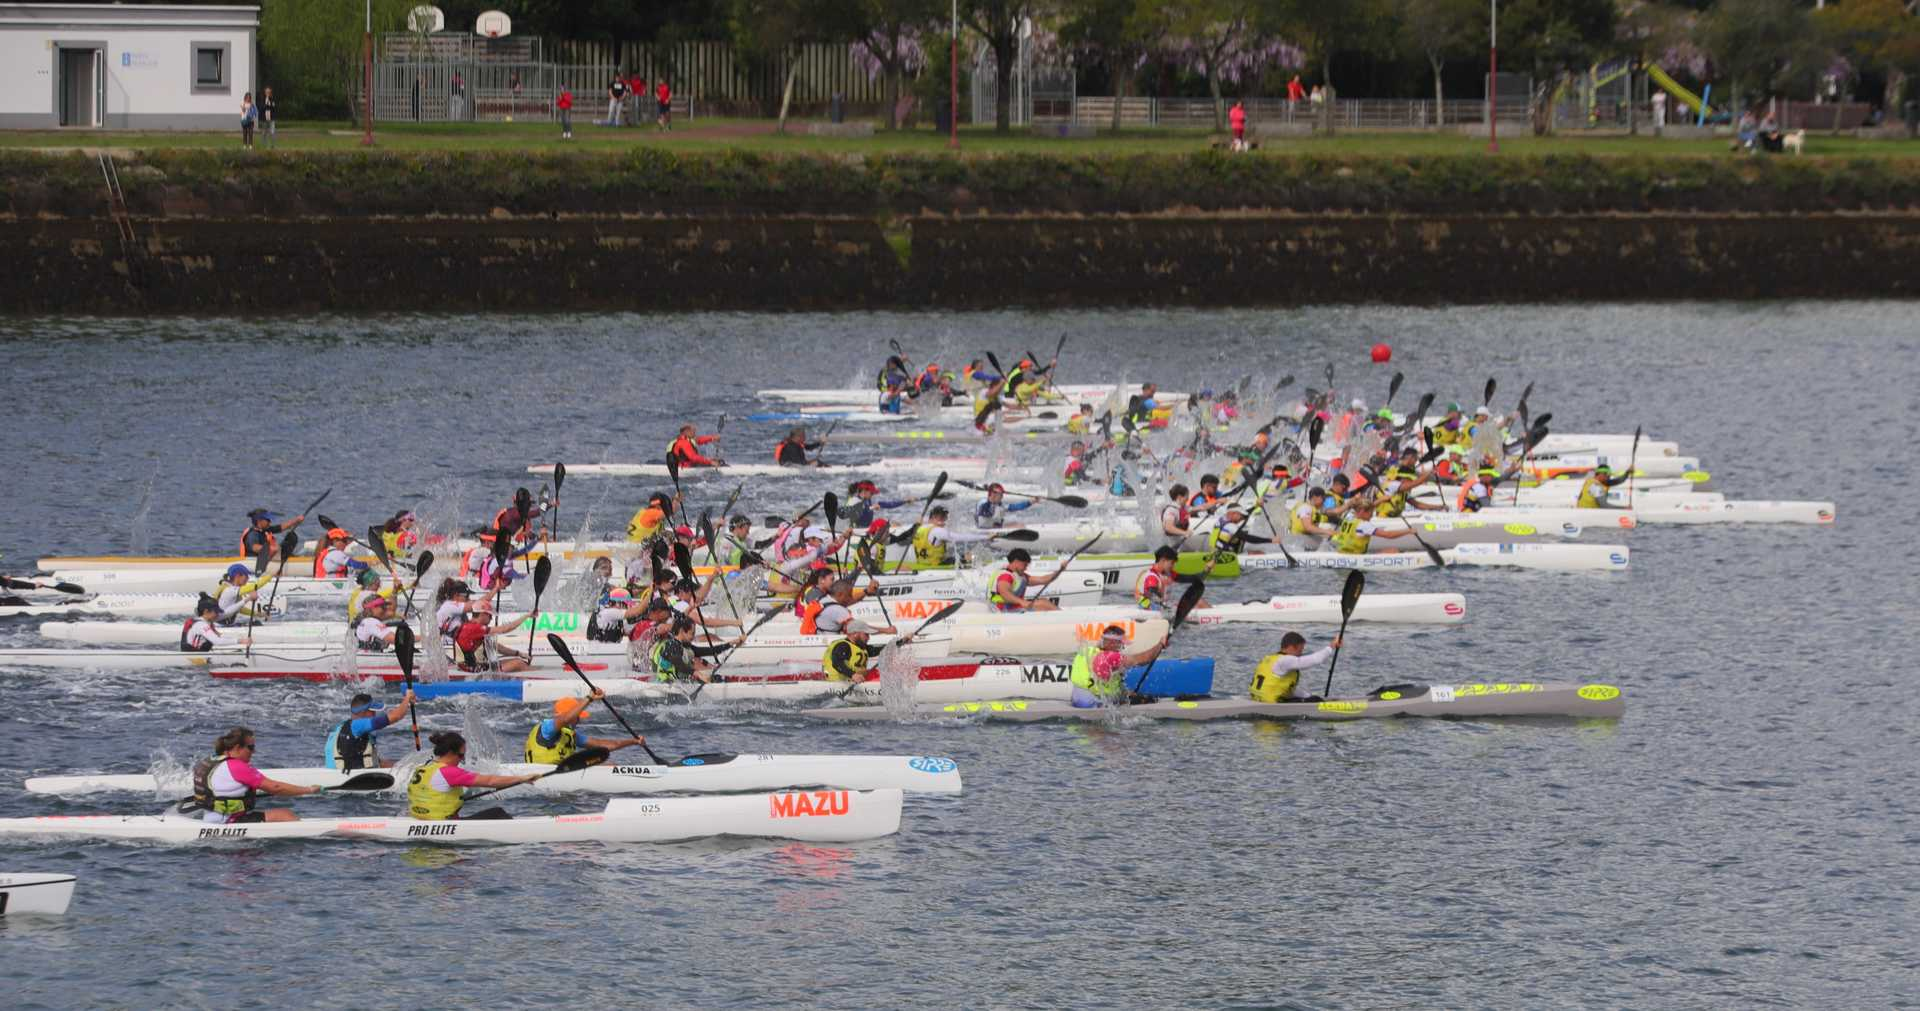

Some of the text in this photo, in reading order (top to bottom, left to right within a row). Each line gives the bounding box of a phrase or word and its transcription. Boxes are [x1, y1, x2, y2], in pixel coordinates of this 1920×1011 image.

[1245, 558, 1357, 569] CARBNOLOGY
[1076, 621, 1135, 641] MAU
[1022, 664, 1072, 683] MAZ
[612, 766, 650, 775] ACKUA
[641, 804, 661, 813] 025
[770, 790, 849, 817] MAZU
[199, 828, 248, 839] PRO ELITE
[408, 824, 458, 836] PRO ELITE
